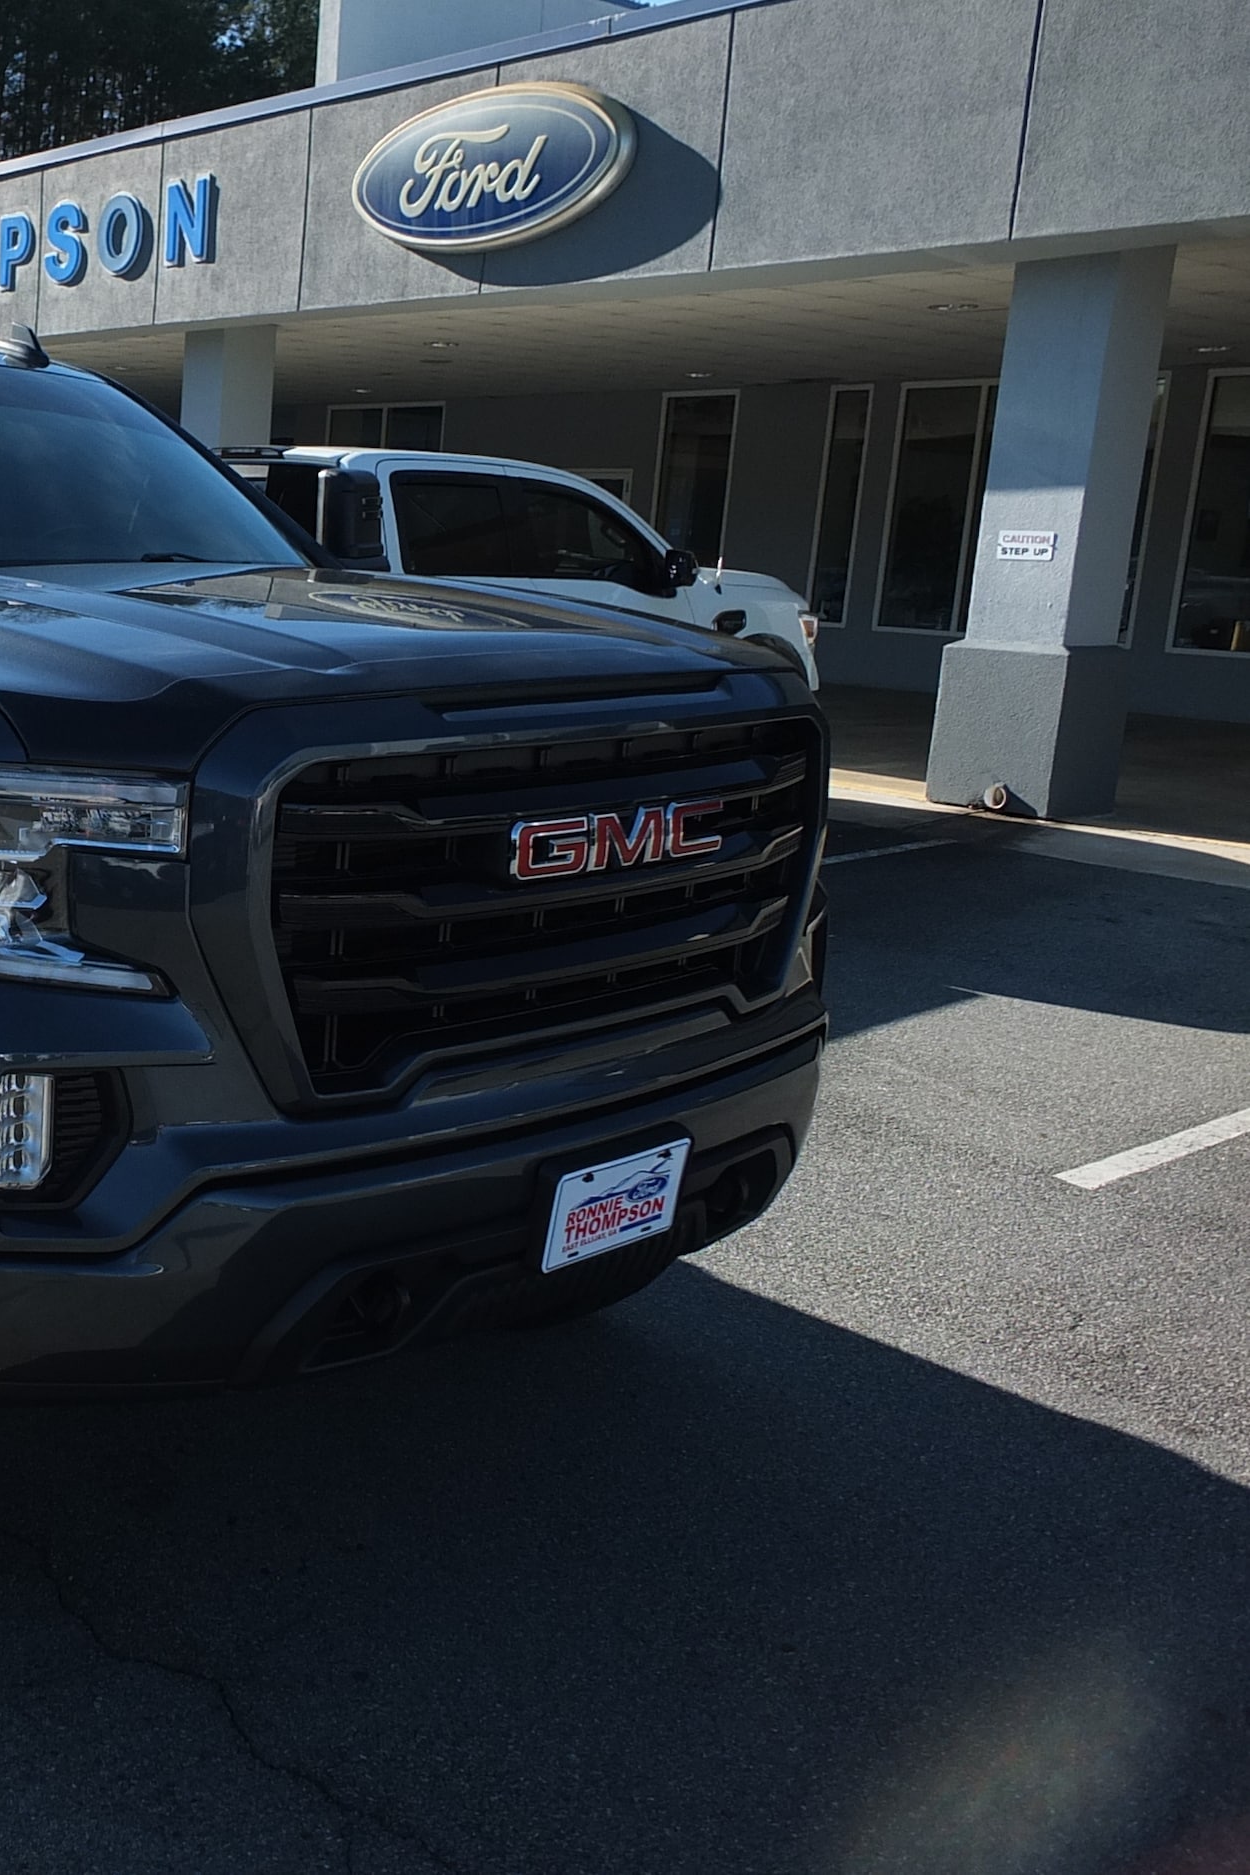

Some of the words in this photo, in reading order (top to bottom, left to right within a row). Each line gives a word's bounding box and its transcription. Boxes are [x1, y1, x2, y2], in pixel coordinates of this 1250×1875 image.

[400, 123, 548, 218] Ford
[1000, 547, 1029, 556] STEP
[1033, 548, 1049, 556] UP
[1002, 534, 1051, 545] CAUTION
[510, 799, 723, 880] GMC
[564, 1195, 665, 1244] THOMPSON
[566, 1195, 624, 1227] RONNIE
